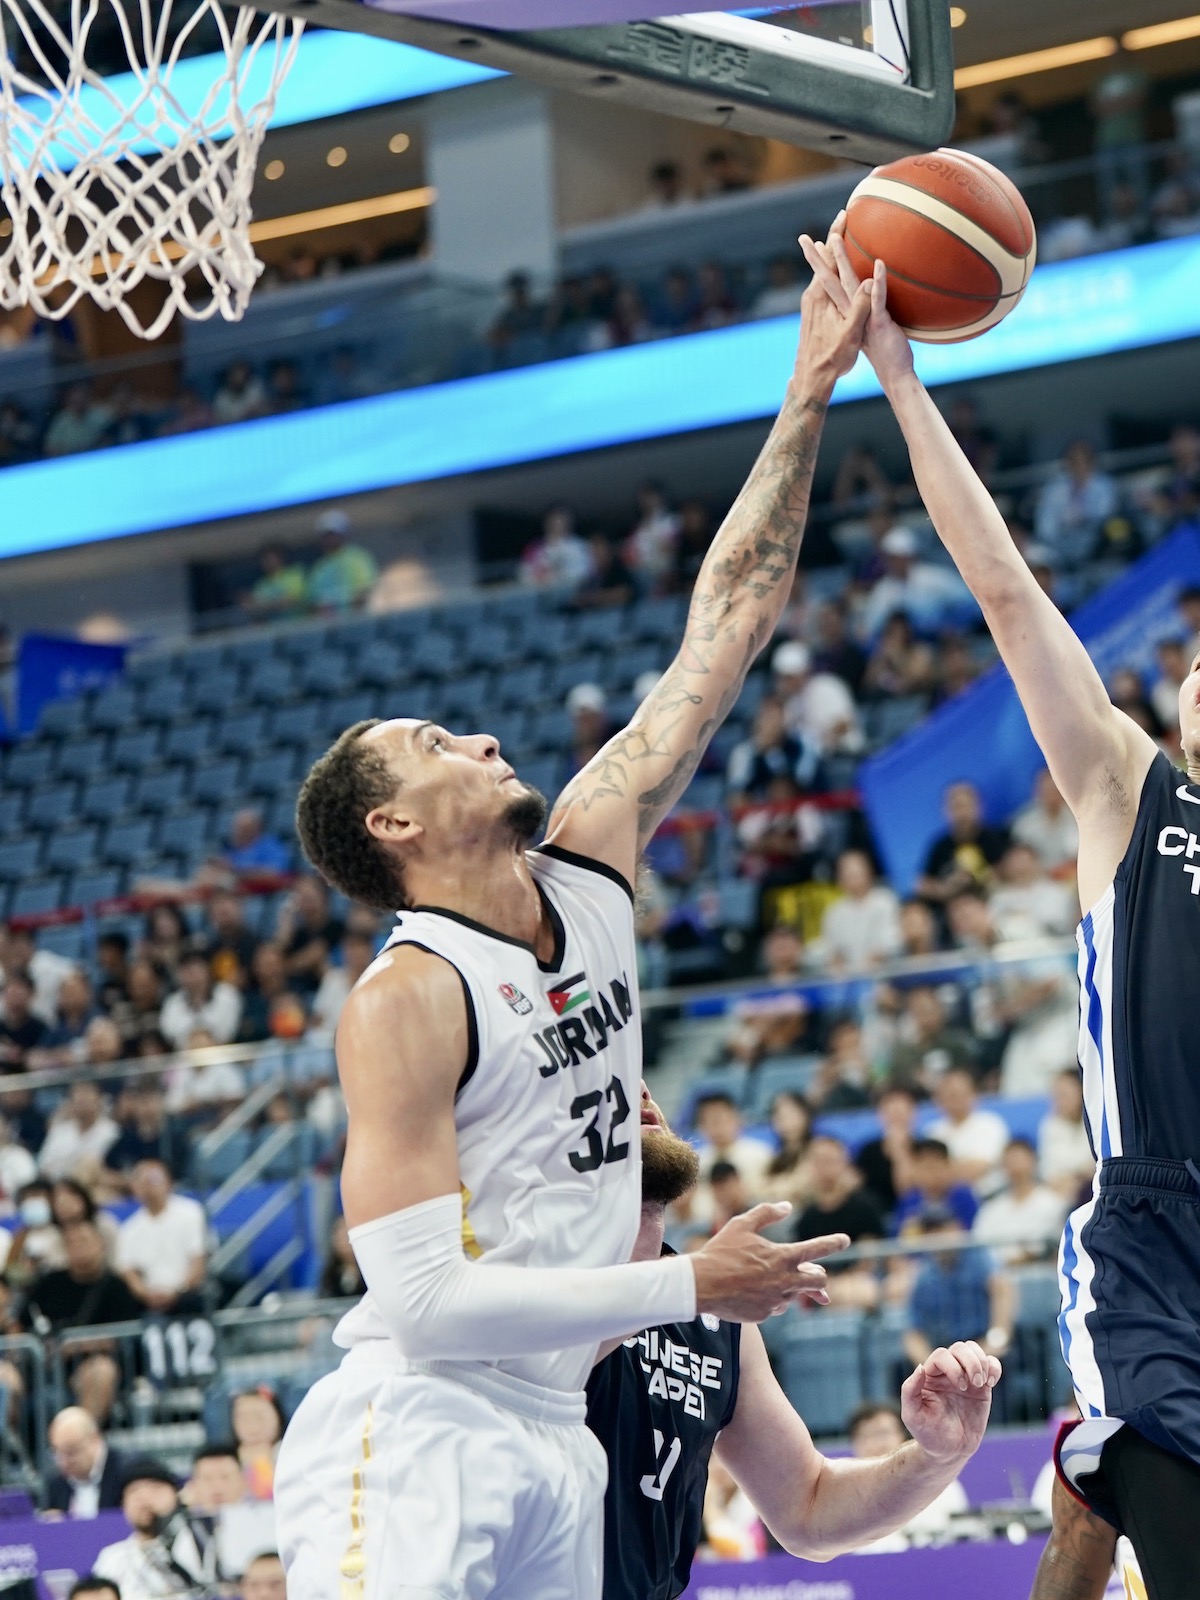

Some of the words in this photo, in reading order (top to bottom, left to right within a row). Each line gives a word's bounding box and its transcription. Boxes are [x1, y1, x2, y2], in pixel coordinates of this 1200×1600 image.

[532, 971, 633, 1079] JORDAN
[568, 1074, 630, 1174] 32
[142, 1318, 217, 1379] 112
